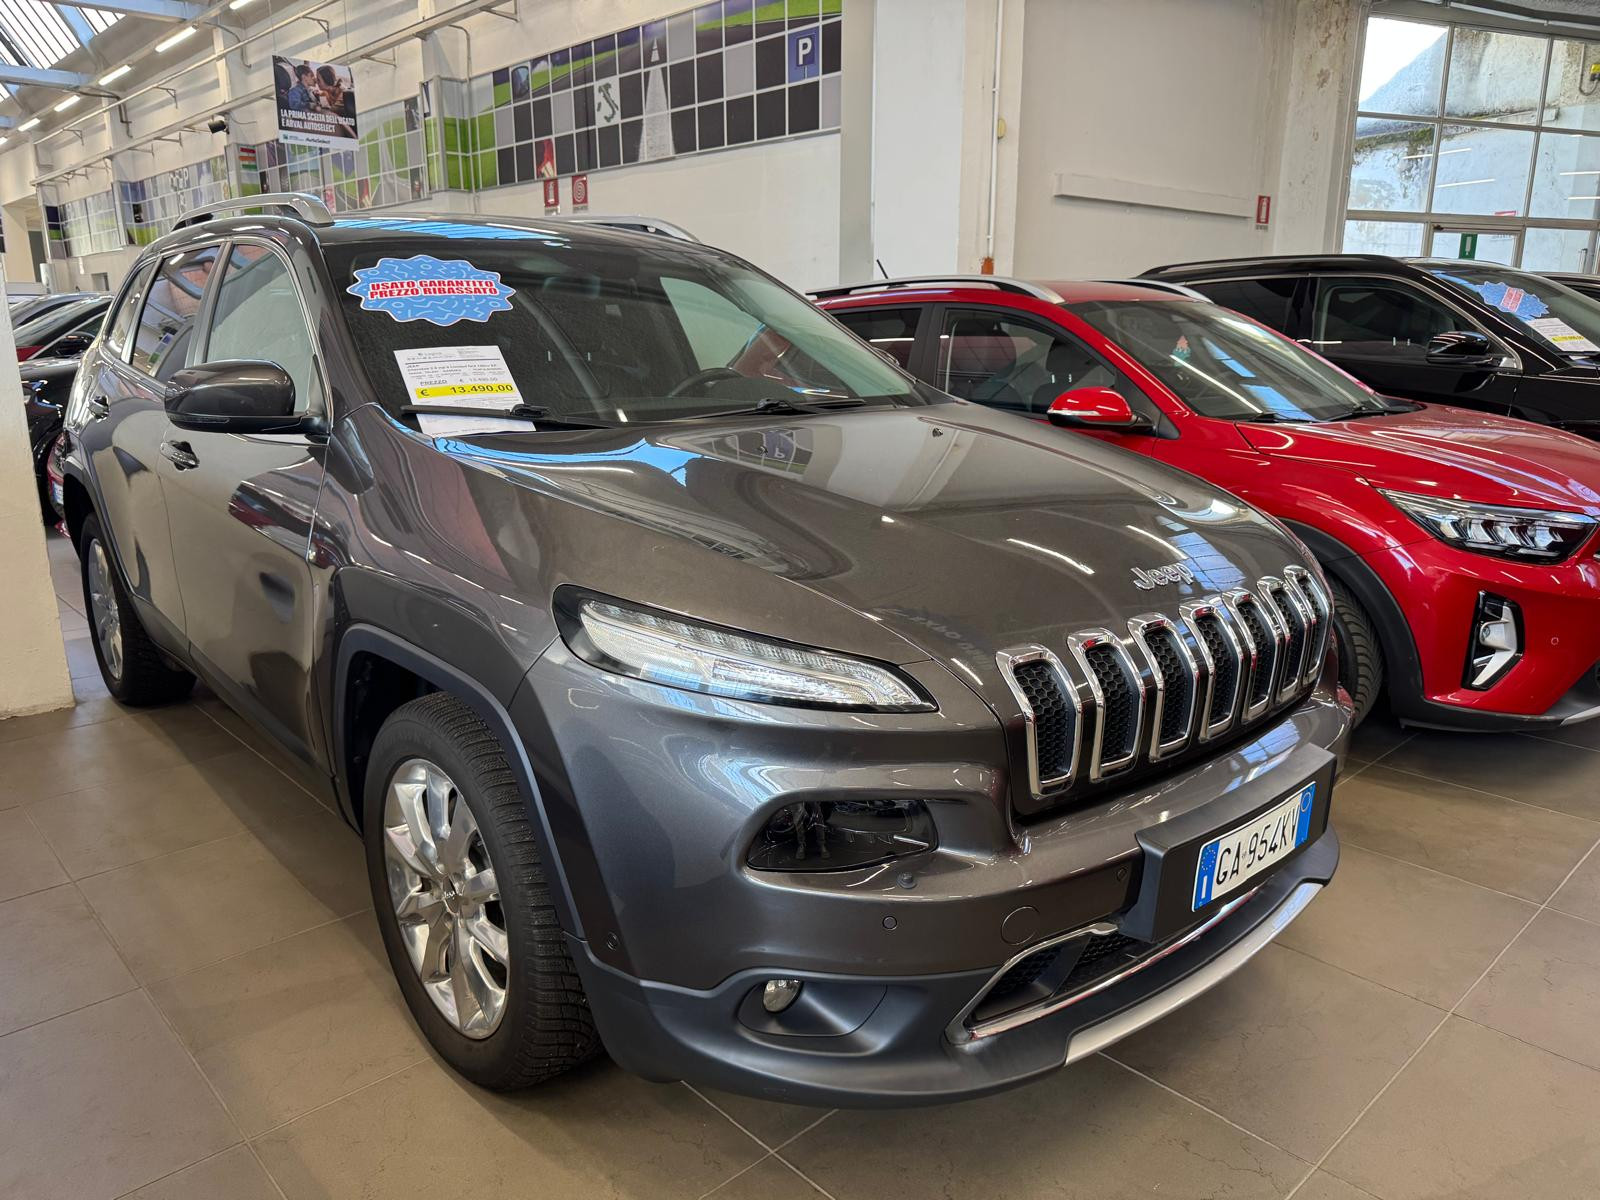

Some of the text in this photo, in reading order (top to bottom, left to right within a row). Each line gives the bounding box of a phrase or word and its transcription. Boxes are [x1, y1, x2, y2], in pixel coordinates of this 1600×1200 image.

[798, 37, 812, 65] P
[280, 108, 288, 118] LA
[288, 109, 306, 120] PRIMA
[306, 112, 326, 122] SCELTA
[286, 119, 303, 129] ARVAL
[303, 121, 336, 132] AUTOSELECT
[370, 279, 495, 291] USATO GARANTITO
[368, 286, 499, 299] PREZZO RIBASSATO
[420, 384, 514, 397] € 13.490,00
[1130, 562, 1195, 590] Jeep
[1215, 804, 1301, 886] GA 954KV
